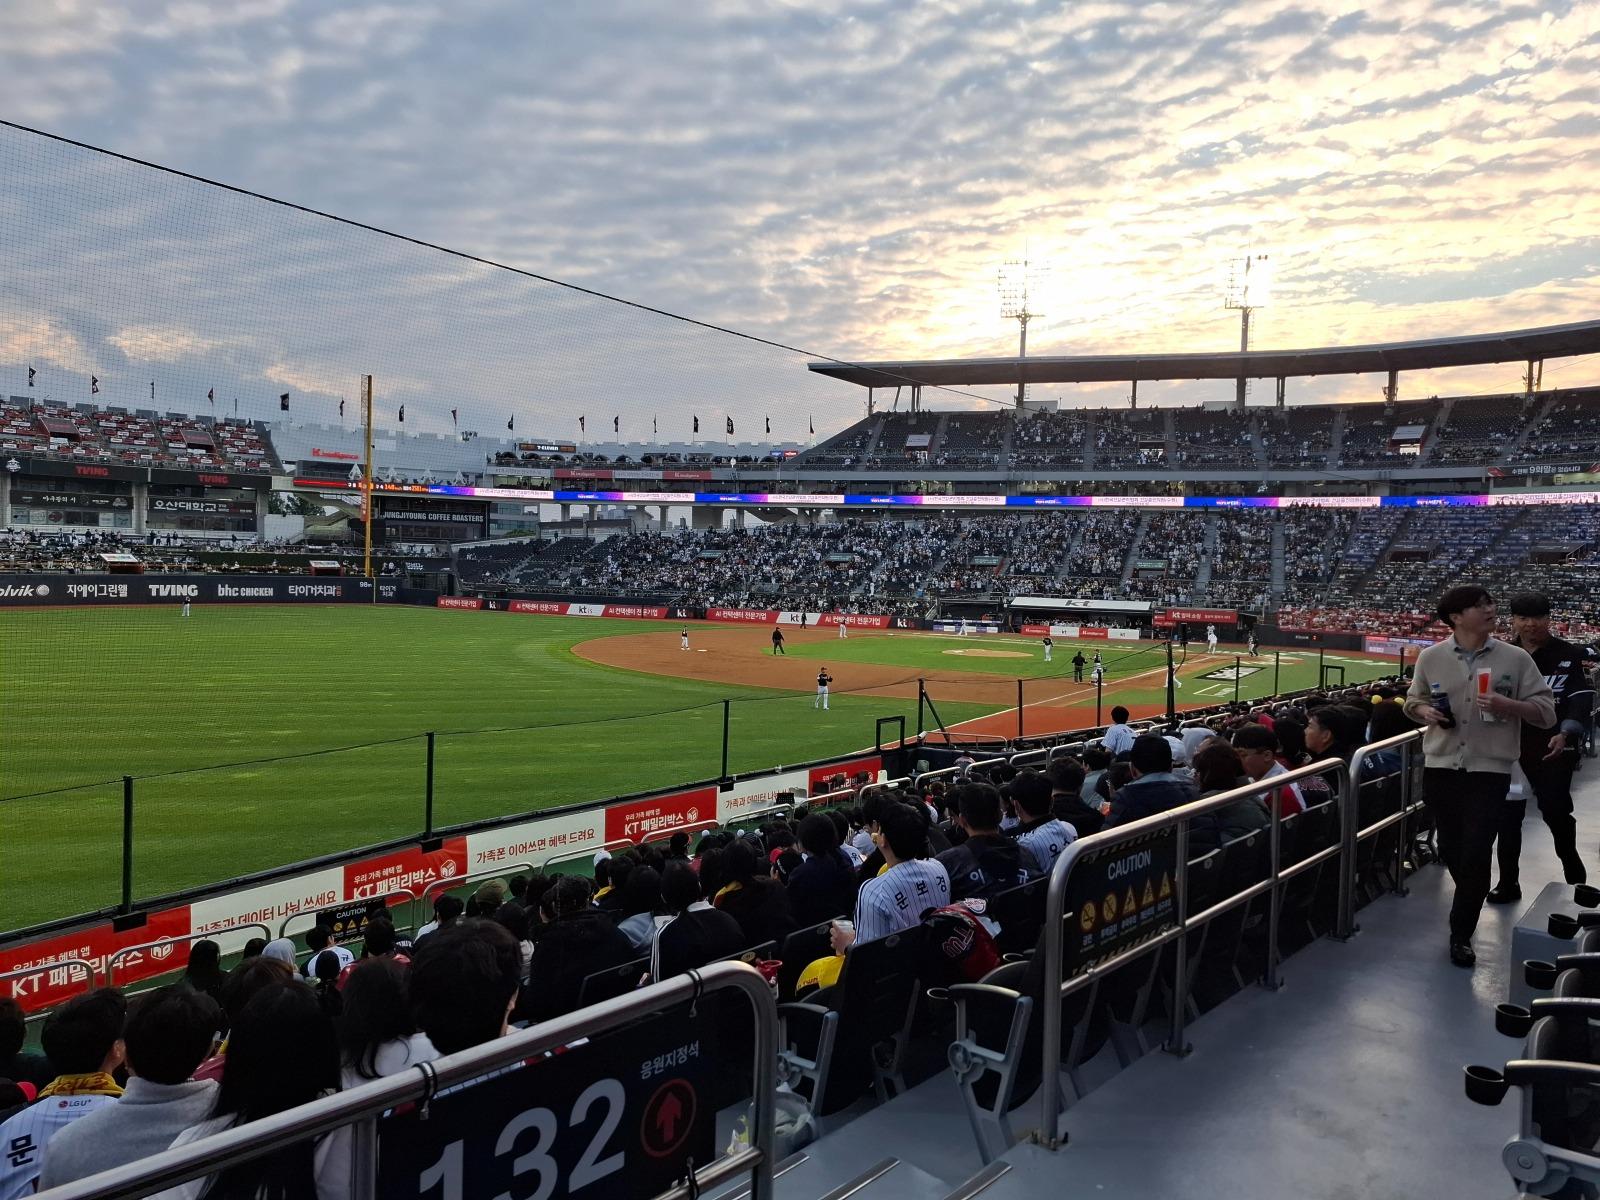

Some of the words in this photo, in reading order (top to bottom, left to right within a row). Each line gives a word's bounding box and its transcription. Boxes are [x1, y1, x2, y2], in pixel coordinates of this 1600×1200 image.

[76, 465, 109, 477] TVING
[154, 500, 217, 512] 오산대학교
[382, 511, 427, 520] JUNGJIYOUNG
[428, 513, 451, 521] COFFEE
[452, 514, 484, 522] ROASTERS
[149, 584, 199, 597] TVING
[218, 584, 239, 597] bhc
[240, 587, 274, 597] CHICKEN
[288, 585, 337, 597] 타이거치과
[578, 605, 586, 613] kt
[615, 608, 636, 616] 컨택센터
[636, 608, 658, 617] 전문기업
[677, 609, 687, 618] kt
[722, 611, 744, 619] 컨택센터
[744, 611, 767, 620] 전문기업
[790, 614, 800, 622] kt
[856, 617, 881, 626] 전문기업
[897, 618, 907, 627] kt
[725, 796, 746, 809] 가족과
[624, 822, 640, 836] KT
[641, 812, 685, 832] 패밀리박스
[477, 849, 506, 864] 가족폰
[508, 839, 547, 857] 이어쓰면
[569, 828, 596, 844] 드려요
[1107, 848, 1152, 881] CAUTION
[353, 883, 374, 901] KT
[376, 866, 437, 895] 패밀리박스
[354, 874, 368, 885] 우리
[368, 869, 382, 880] 가족
[238, 906, 275, 924] 데이터
[277, 899, 301, 918] 나눠
[303, 890, 337, 911] 쓰세요
[336, 906, 367, 920] CAUTION
[80, 946, 91, 957] 앱
[12, 972, 44, 999] KT
[640, 1041, 700, 1080] 응원지정석
[419, 1077, 626, 1200] 132
[7, 1133, 38, 1168] 문
